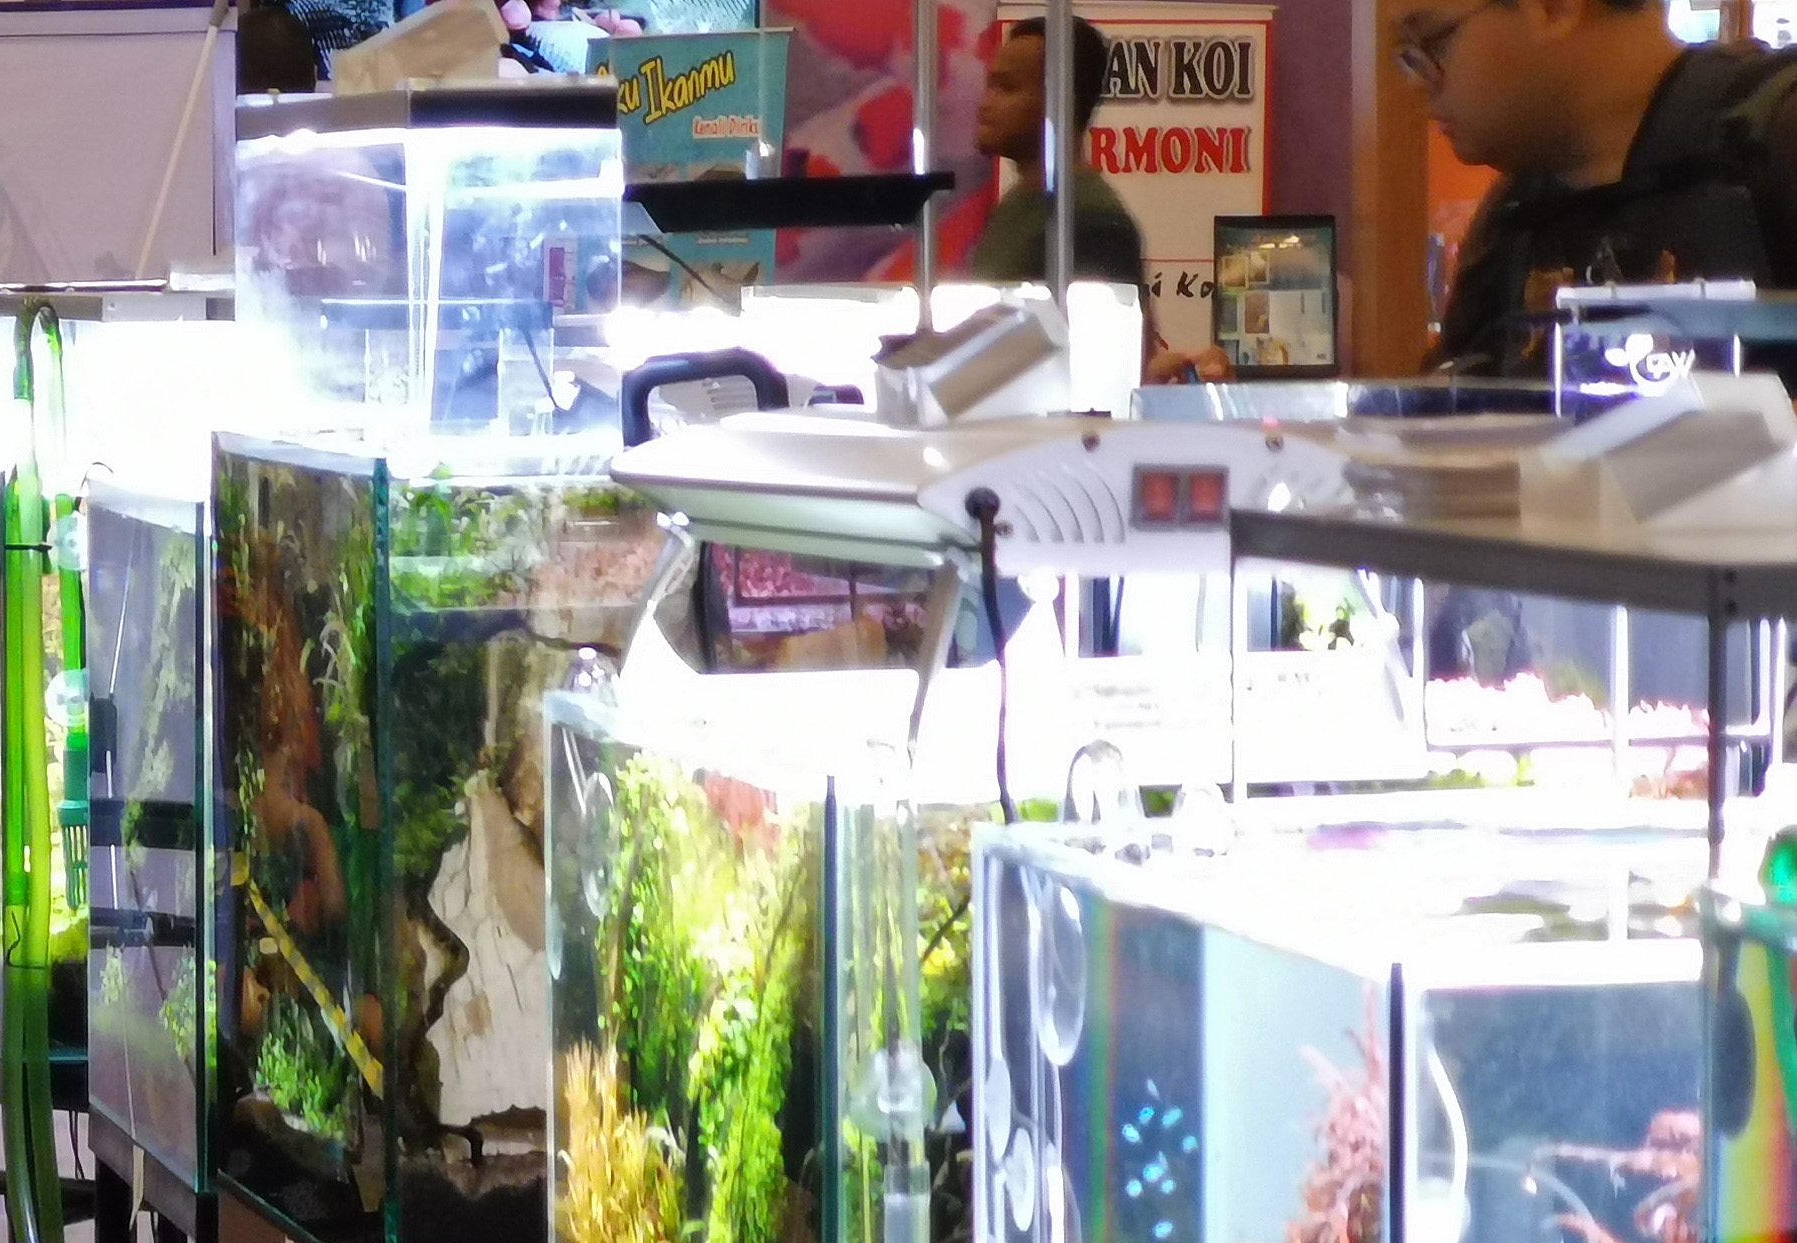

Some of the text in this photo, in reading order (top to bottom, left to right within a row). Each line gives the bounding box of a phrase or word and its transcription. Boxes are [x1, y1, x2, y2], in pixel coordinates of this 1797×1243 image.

[638, 50, 737, 126] Ikanmu
[1171, 40, 1252, 97] KOI
[1089, 126, 1247, 174] RMONI
